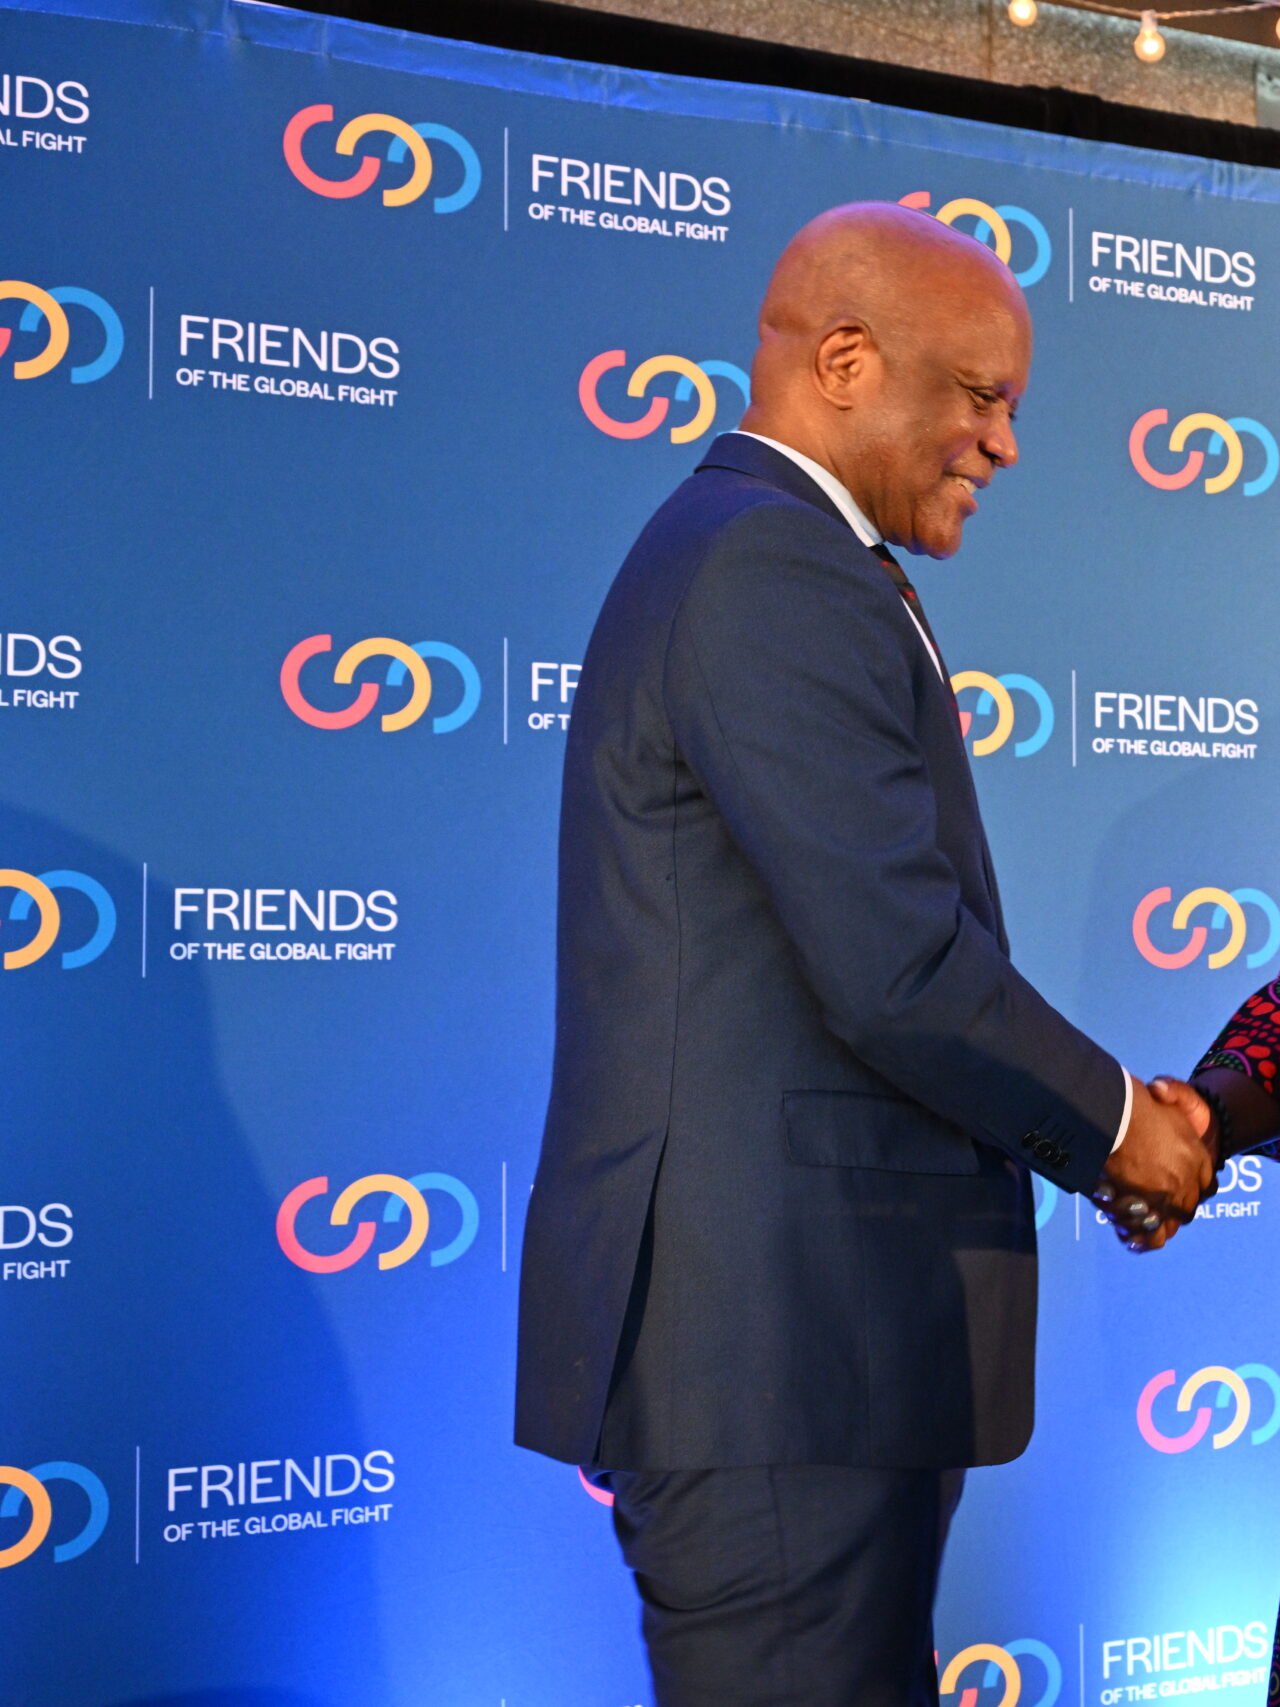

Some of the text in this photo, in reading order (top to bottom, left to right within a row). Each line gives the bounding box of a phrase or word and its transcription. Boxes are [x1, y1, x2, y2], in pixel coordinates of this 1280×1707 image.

[22, 130, 87, 154] FIGHT
[532, 153, 731, 216] FRIENDS
[528, 203, 729, 242] OF THE GLOBAL FIGHT
[1091, 231, 1256, 287] FRIENDS
[1089, 276, 1255, 312] OF THE GLOBAL FIGHT
[180, 314, 400, 379] FRIENDS
[175, 368, 398, 407] OF THE GLOBAL FIGHT
[13, 688, 80, 709] FIGHT
[1094, 691, 1259, 735] FRIENDS
[527, 712, 556, 730] OF
[1092, 737, 1257, 759] OF THE GLOBAL FIGHT
[174, 888, 398, 932] FRIENDS
[169, 942, 396, 960] OF THE GLOBAL FIGHT
[1215, 1201, 1261, 1217] FIGHT
[3, 1259, 71, 1281] FIGHT
[168, 1450, 395, 1511] FRIENDS
[163, 1503, 393, 1542] OF THE GLOBAL FIGHT
[1103, 1621, 1268, 1679] FRIENDS
[1101, 1666, 1267, 1706] OF THE GLOBAL FIGHT
